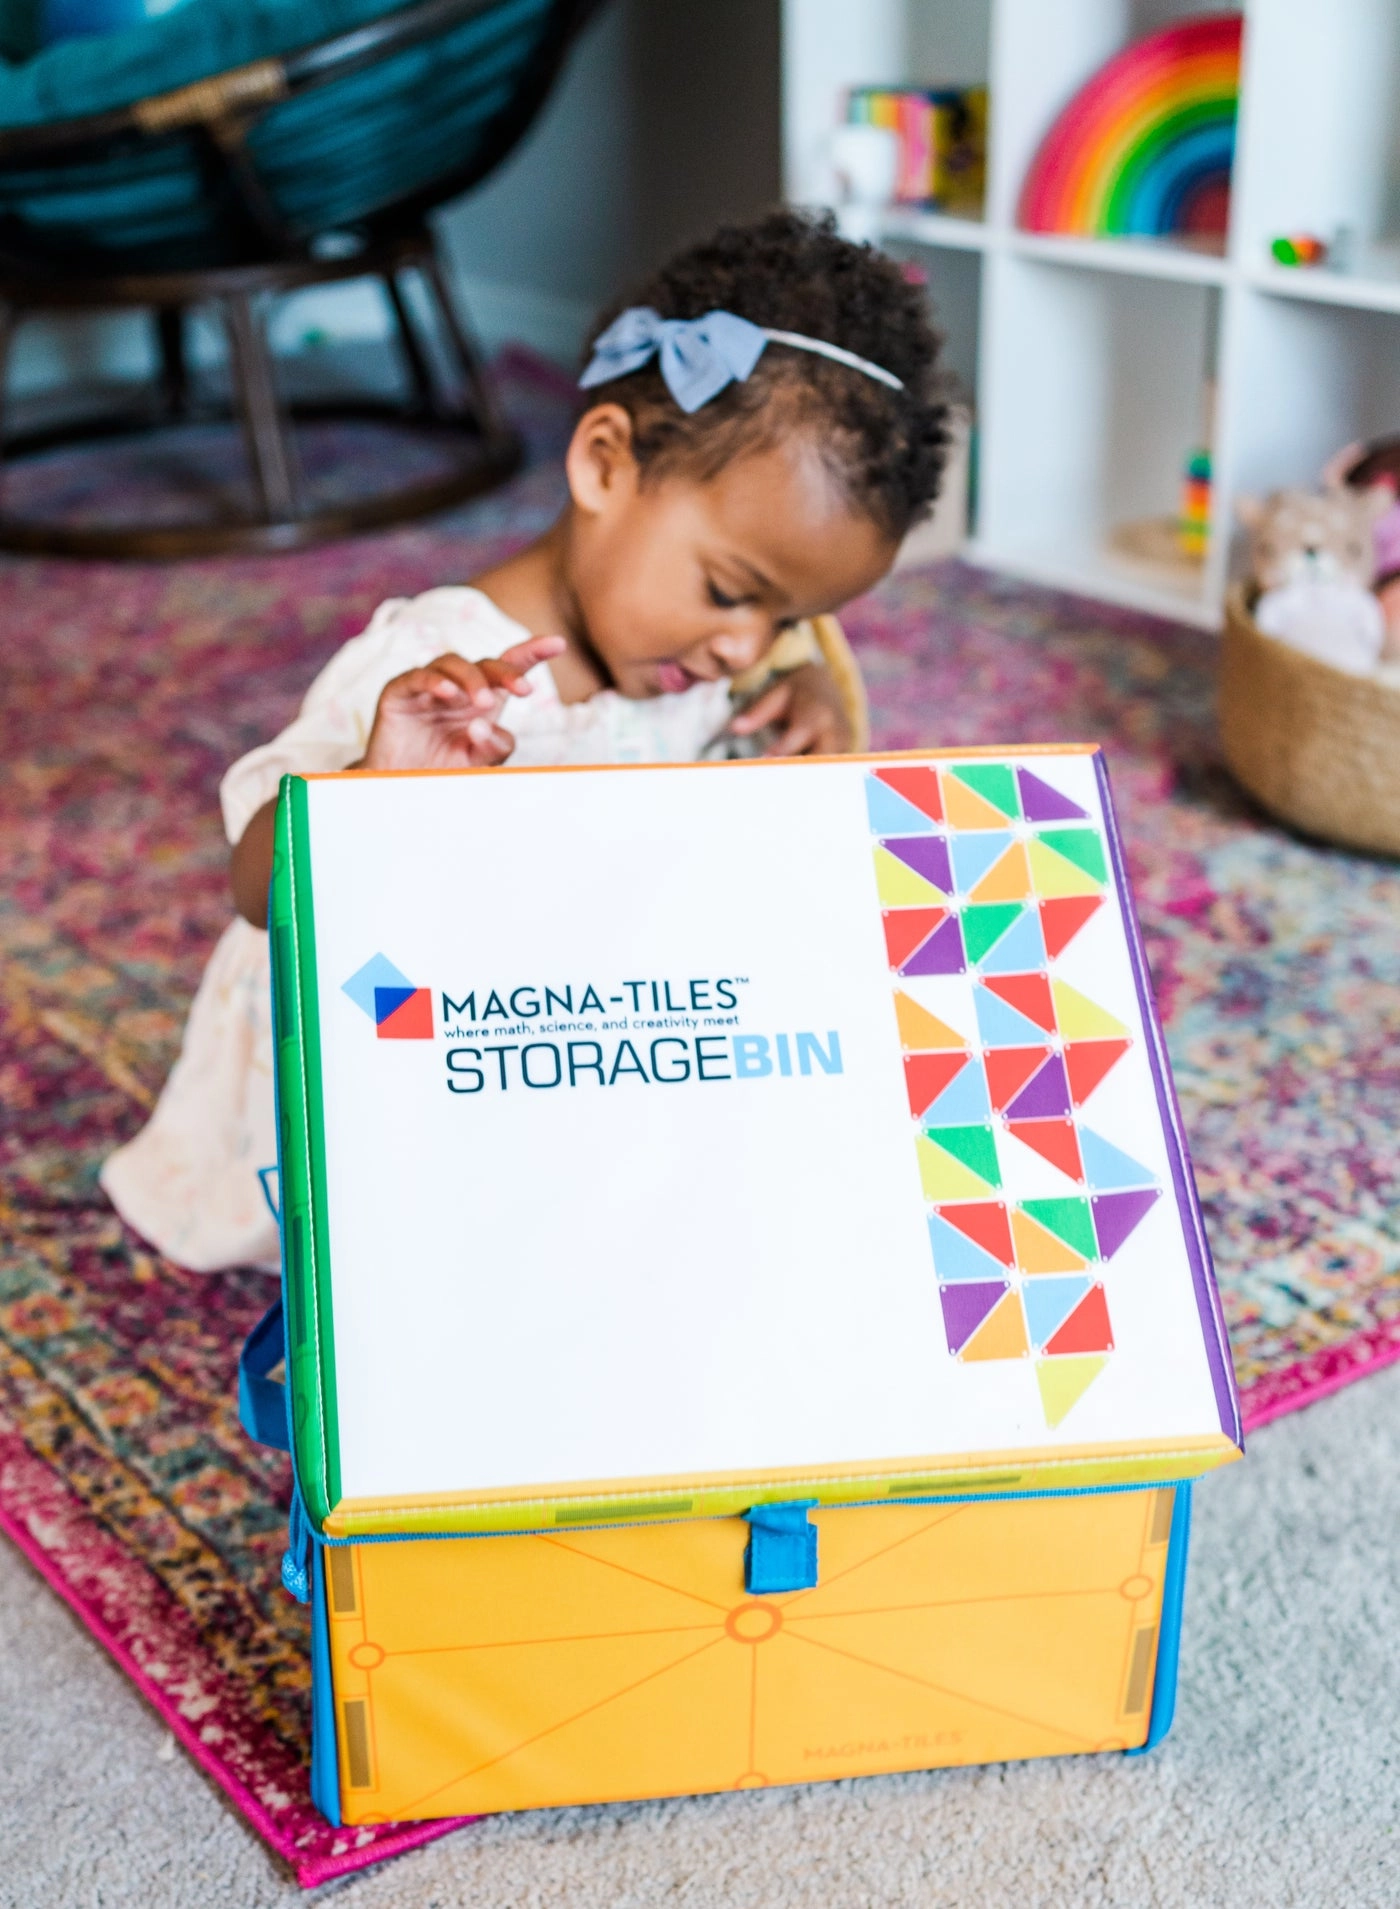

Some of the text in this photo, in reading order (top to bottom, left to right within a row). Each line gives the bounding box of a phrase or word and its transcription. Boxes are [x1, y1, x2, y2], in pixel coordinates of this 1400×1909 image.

[444, 1014, 740, 1039] where math, science, and creativity meet
